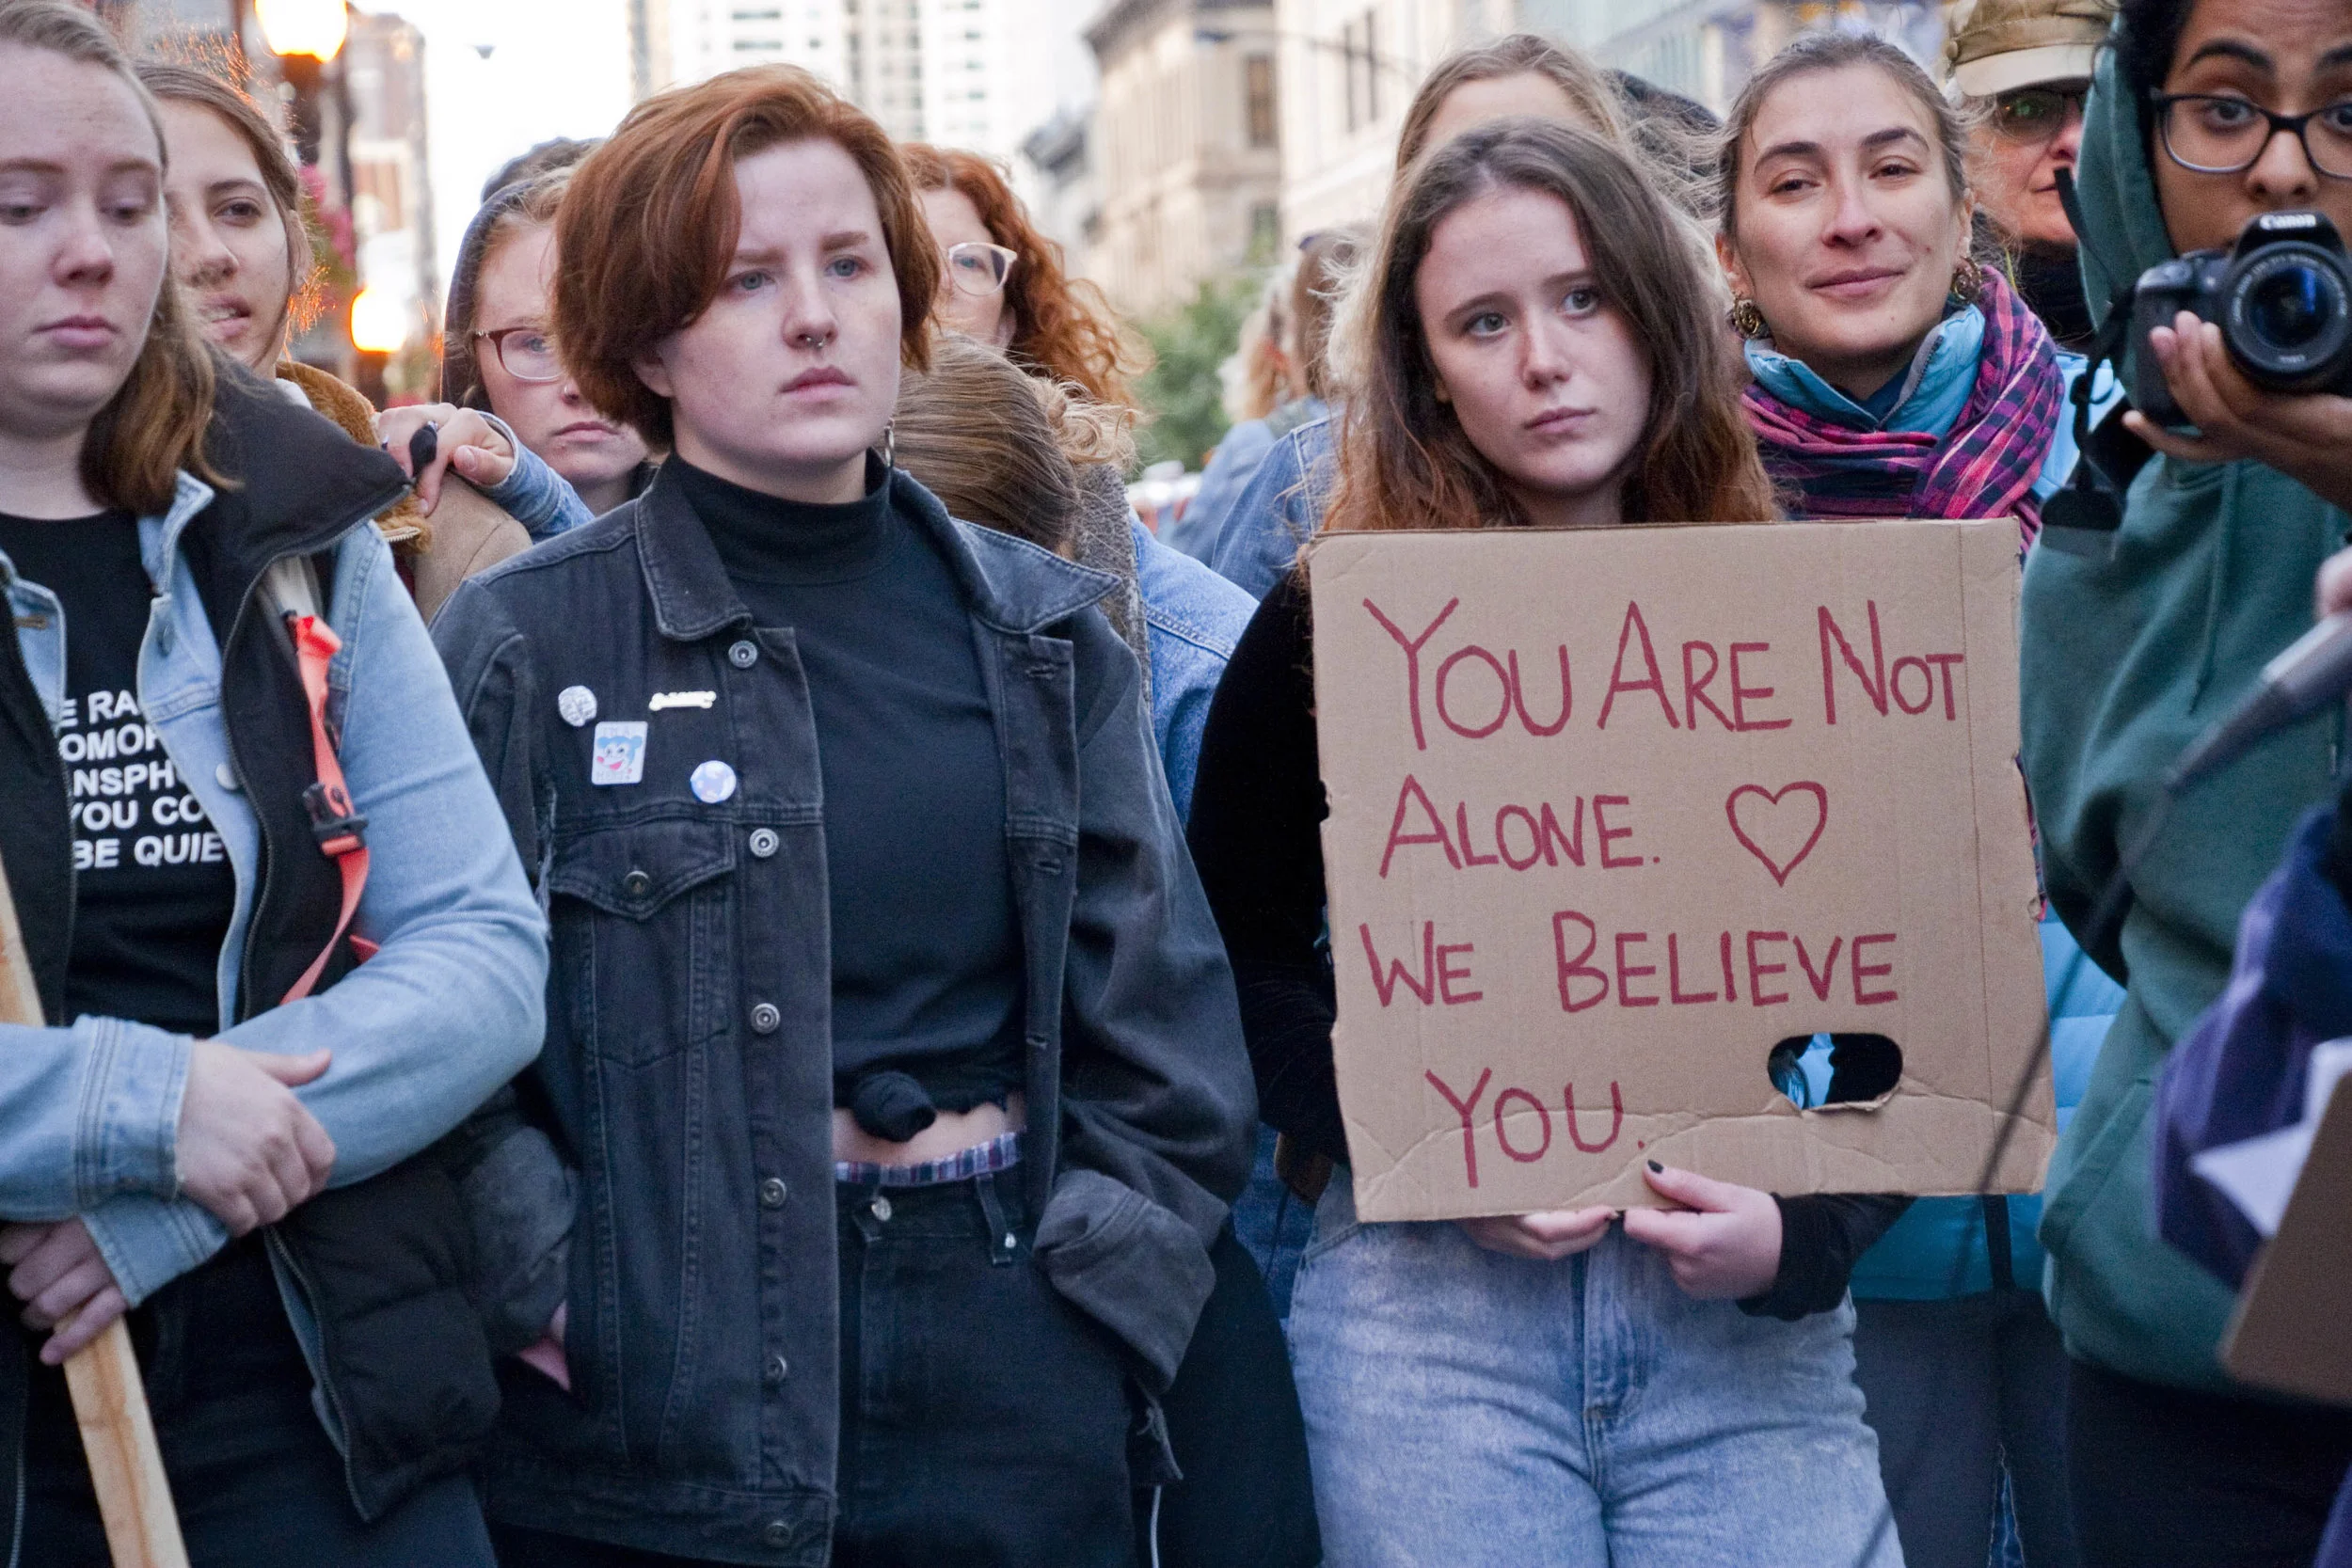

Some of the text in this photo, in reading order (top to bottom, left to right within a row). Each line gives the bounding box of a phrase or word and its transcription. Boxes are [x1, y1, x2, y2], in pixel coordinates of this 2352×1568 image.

[87, 689, 140, 724] RA
[1362, 597, 1964, 751] YOU ARE NOT
[72, 832, 224, 870] BE QUIE
[1379, 773, 1661, 879] ALONE.
[1359, 910, 1899, 1013] WE BELIEVE
[1425, 1068, 1646, 1188] YOU.
